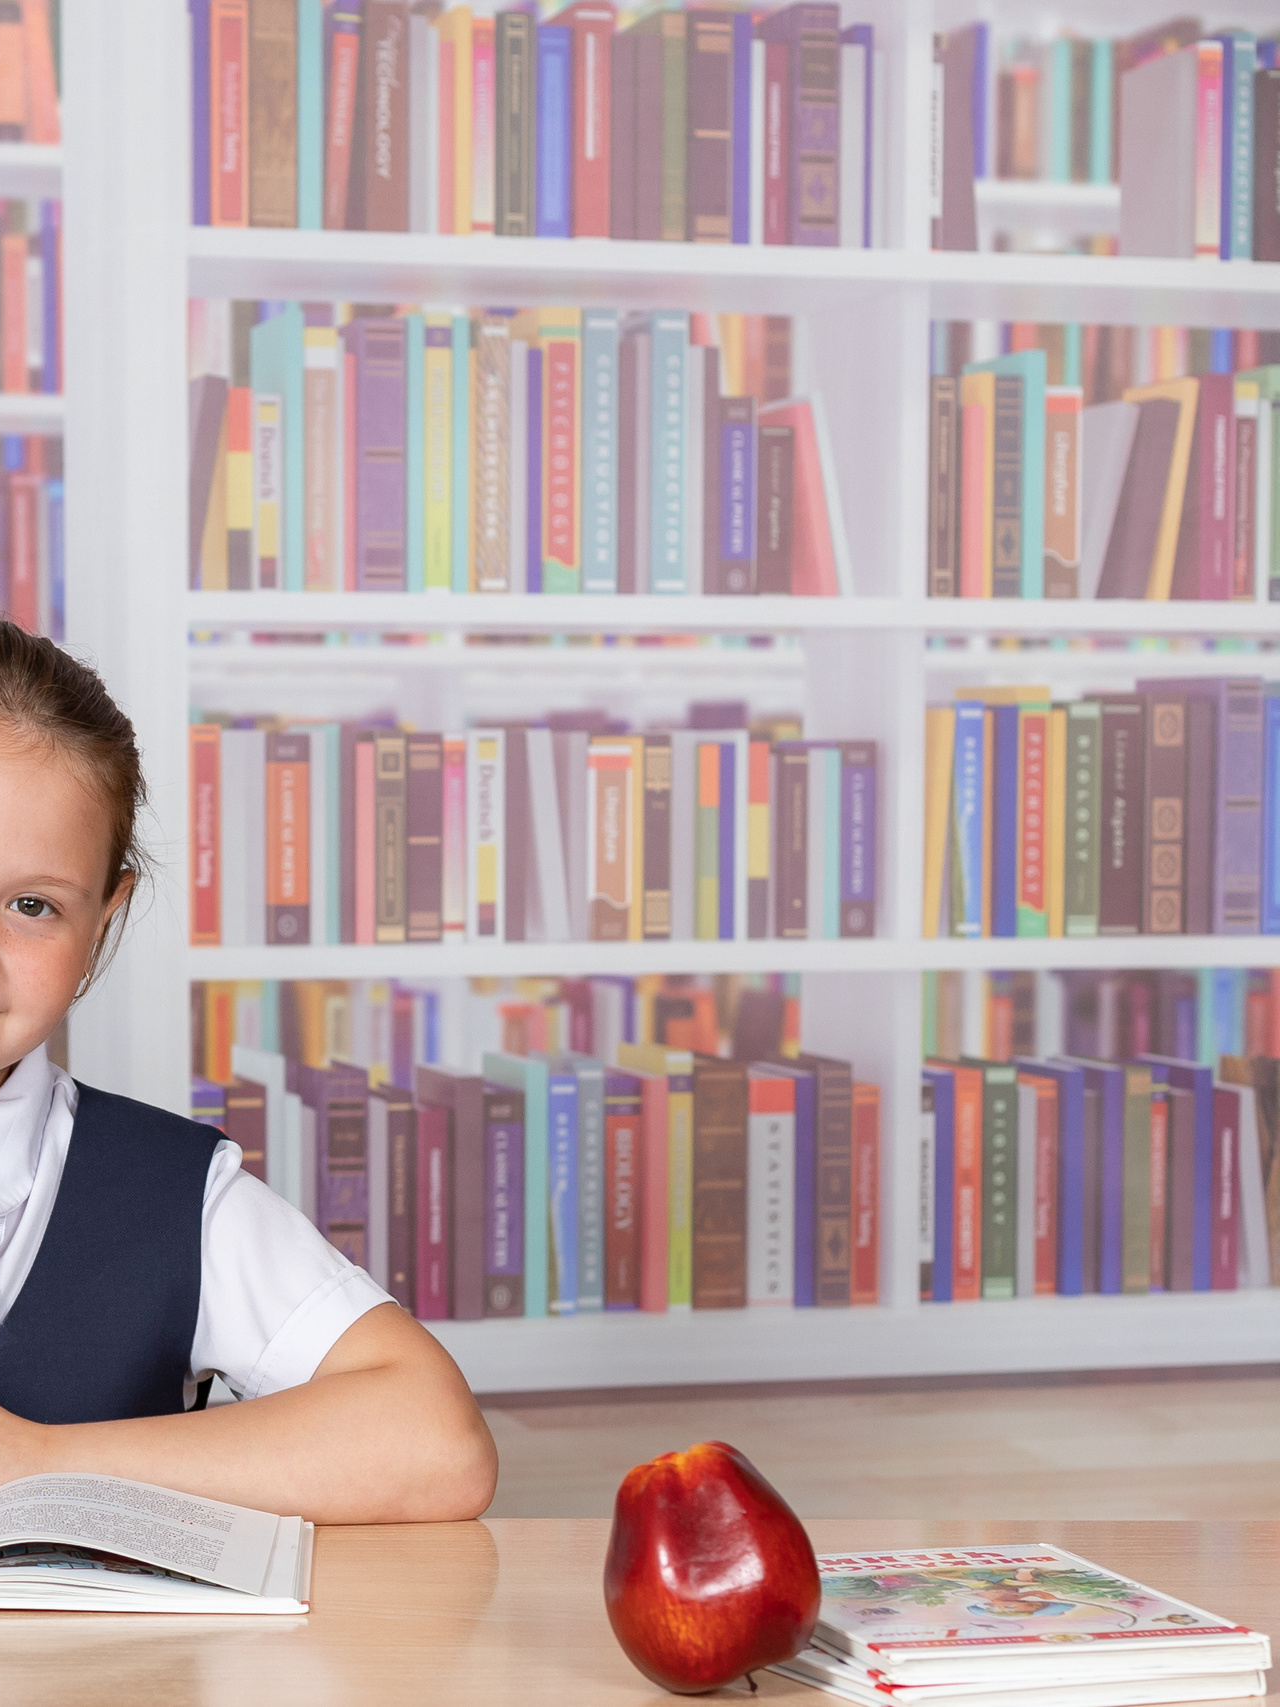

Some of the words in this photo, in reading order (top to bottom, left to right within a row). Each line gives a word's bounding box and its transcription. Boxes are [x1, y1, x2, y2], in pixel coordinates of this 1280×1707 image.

[259, 427, 276, 499] Deutsch
[553, 361, 570, 547] PSYCHOLOGY
[596, 354, 610, 562] CONSTRUCTION
[666, 354, 680, 563] CONSTRUCTION
[1025, 732, 1042, 894] PSYCHOLOGY
[1077, 734, 1091, 862] BIOLOGY
[615, 1128, 634, 1233] BIOLOGY
[768, 1121, 782, 1294] STATISTICS
[993, 1099, 1007, 1225] BIOLOGY
[818, 1552, 1002, 1566] ЧТЕНИ
